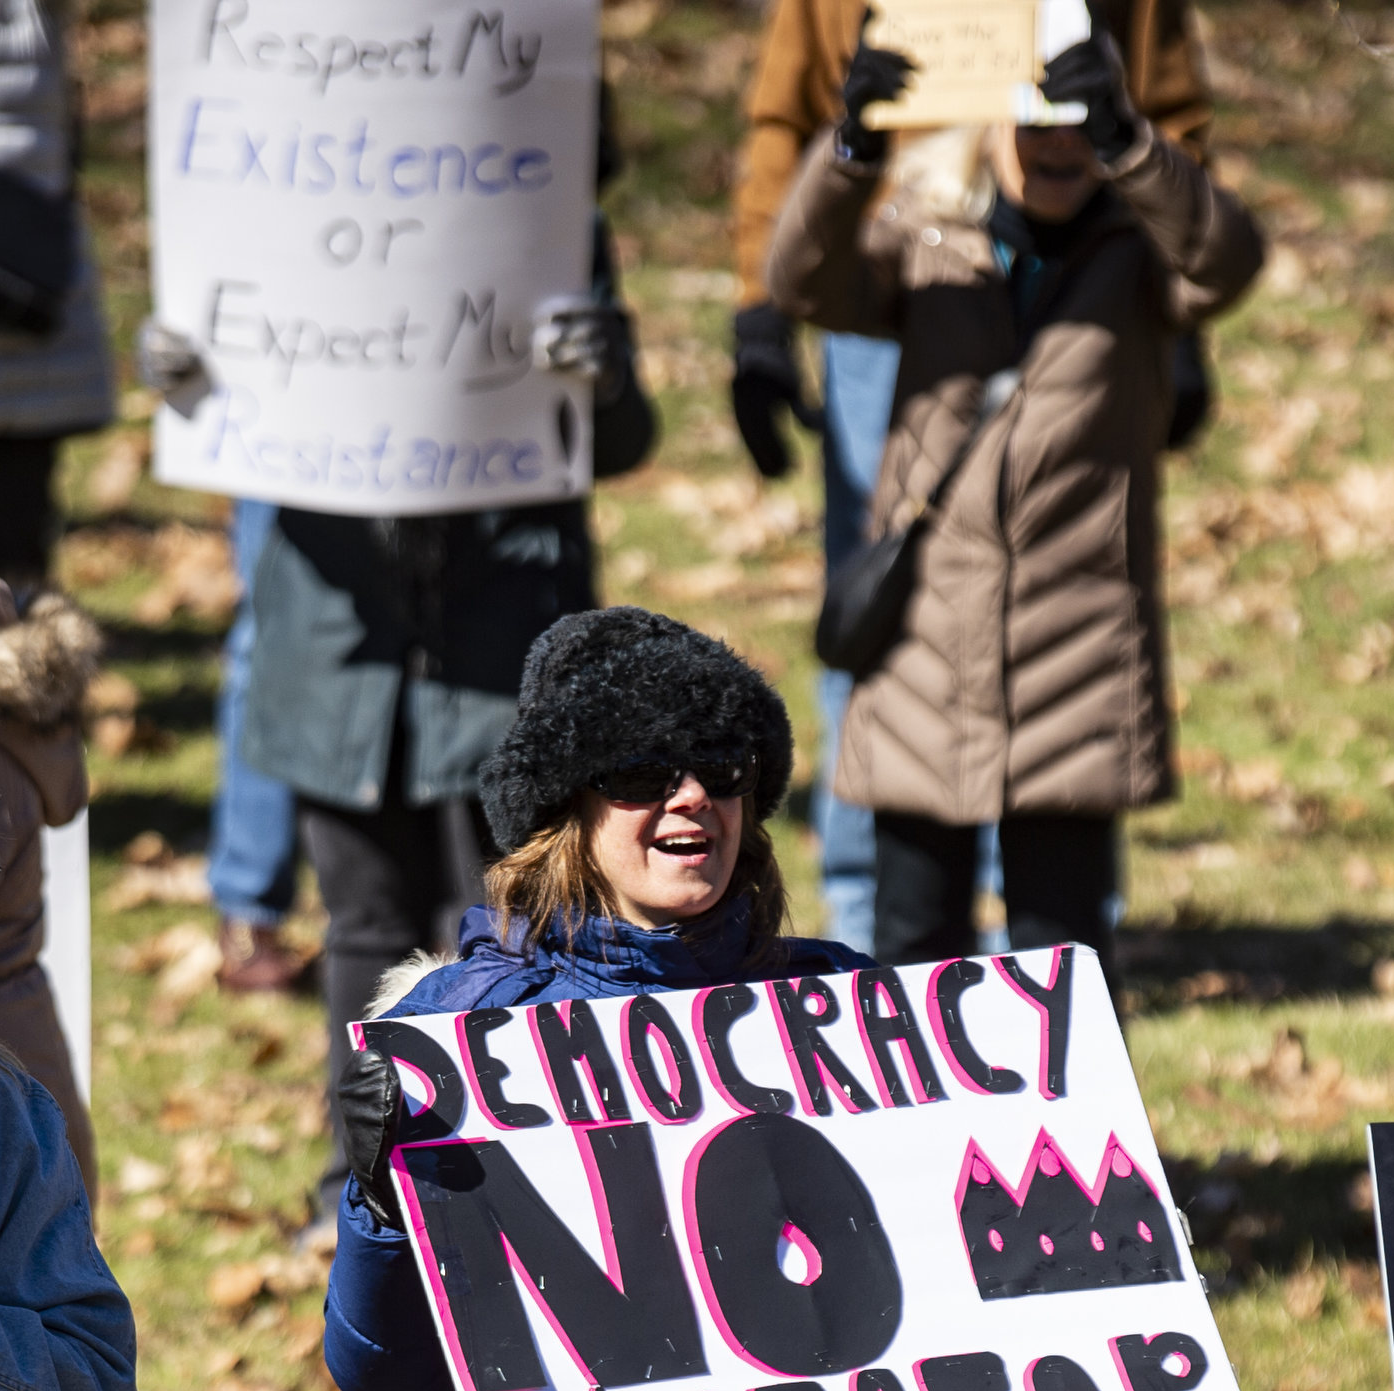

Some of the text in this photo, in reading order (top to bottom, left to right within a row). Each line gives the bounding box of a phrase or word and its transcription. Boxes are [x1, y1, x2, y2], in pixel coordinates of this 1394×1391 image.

[201, 0, 545, 96] Respect My
[177, 98, 555, 197] Existence
[317, 214, 426, 267] or
[206, 278, 429, 388] Expect
[352, 944, 1073, 1141] DEMOCRACY
